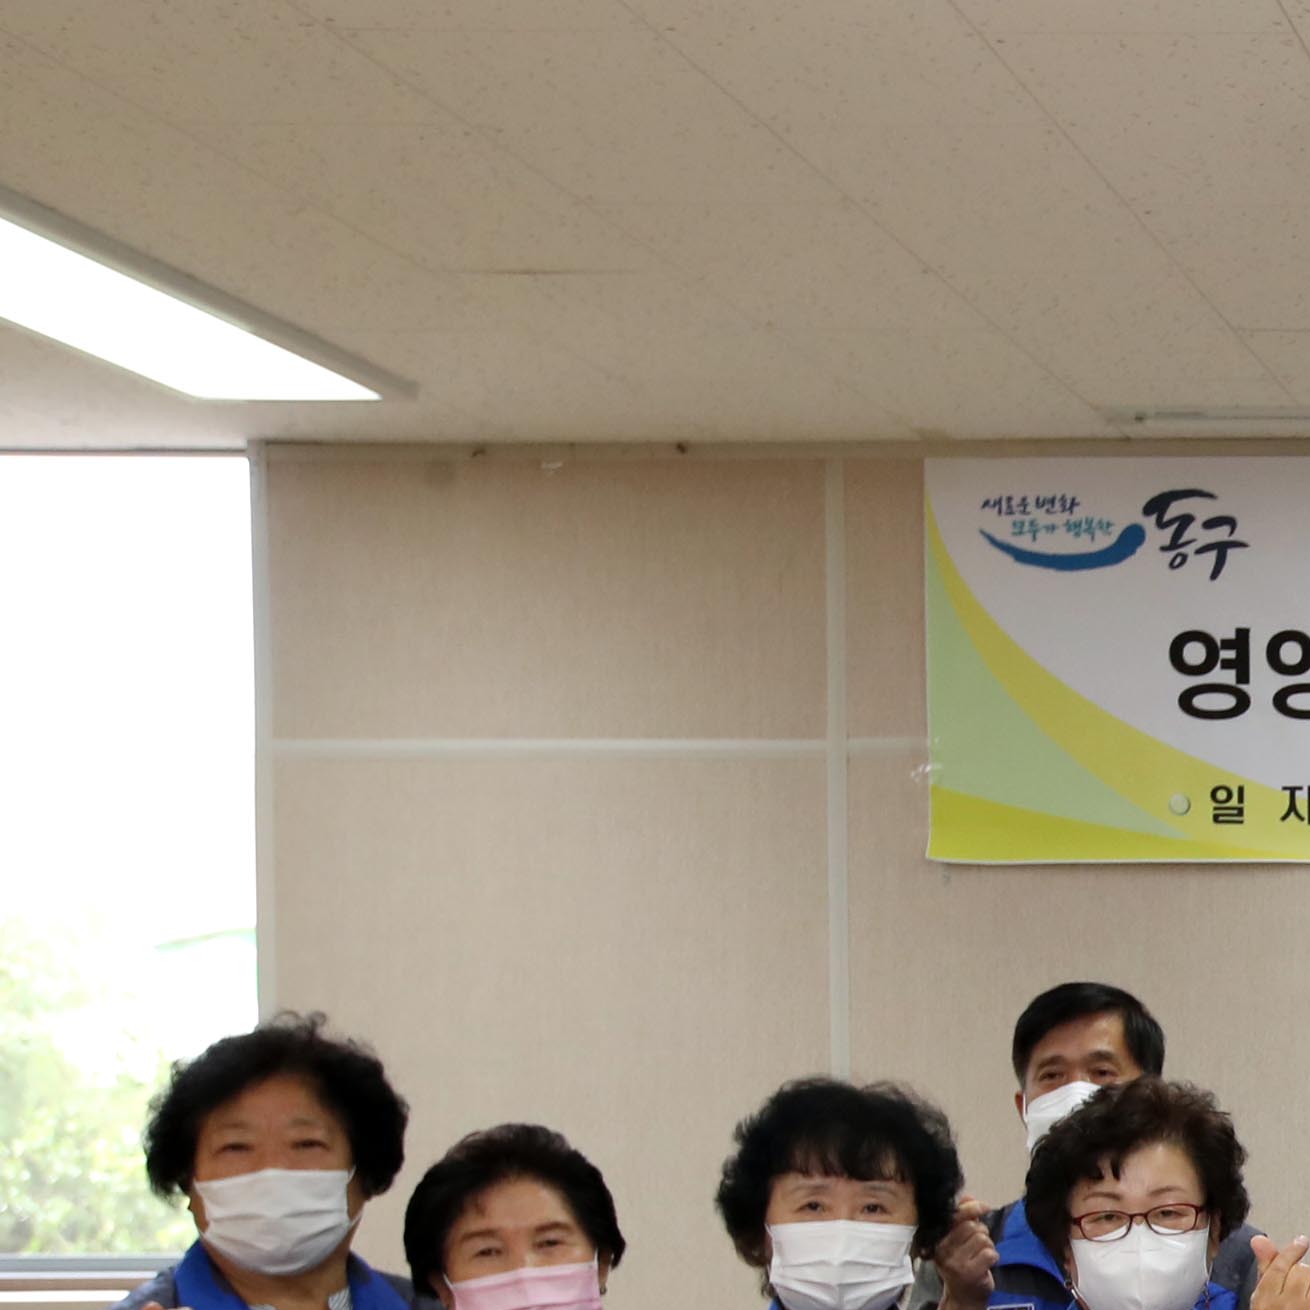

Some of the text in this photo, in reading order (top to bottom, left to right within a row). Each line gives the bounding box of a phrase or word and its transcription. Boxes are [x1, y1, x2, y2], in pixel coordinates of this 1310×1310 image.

[981, 494, 1080, 516] 새로운 변화
[1012, 516, 1114, 542] 모두가 행복한
[1142, 488, 1250, 581] 동구
